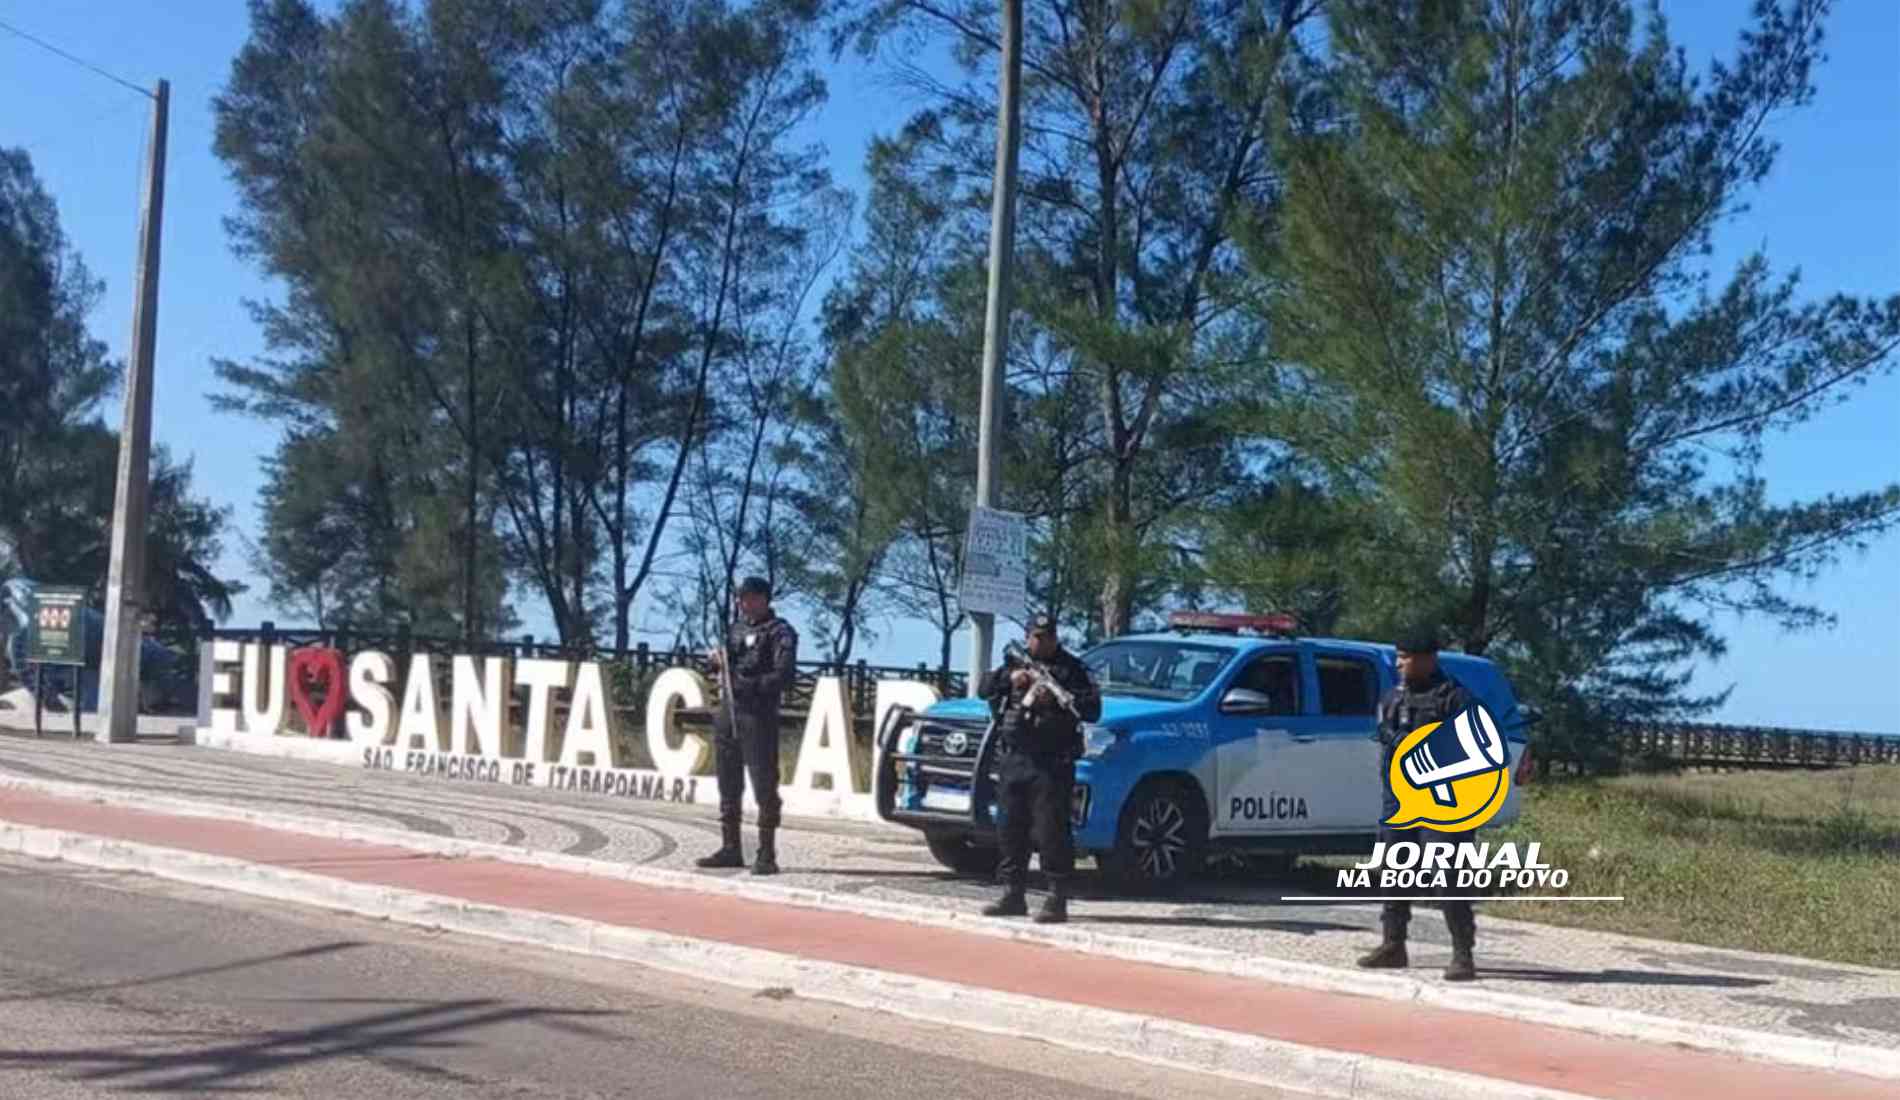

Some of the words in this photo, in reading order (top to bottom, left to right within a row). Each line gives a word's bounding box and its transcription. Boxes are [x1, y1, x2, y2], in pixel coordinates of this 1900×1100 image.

[199, 640, 287, 735] EU
[345, 651, 613, 769] SANTA
[406, 752, 500, 783] FRANCISCO
[512, 762, 535, 785] DE
[1231, 791, 1308, 820] POLÍCIA
